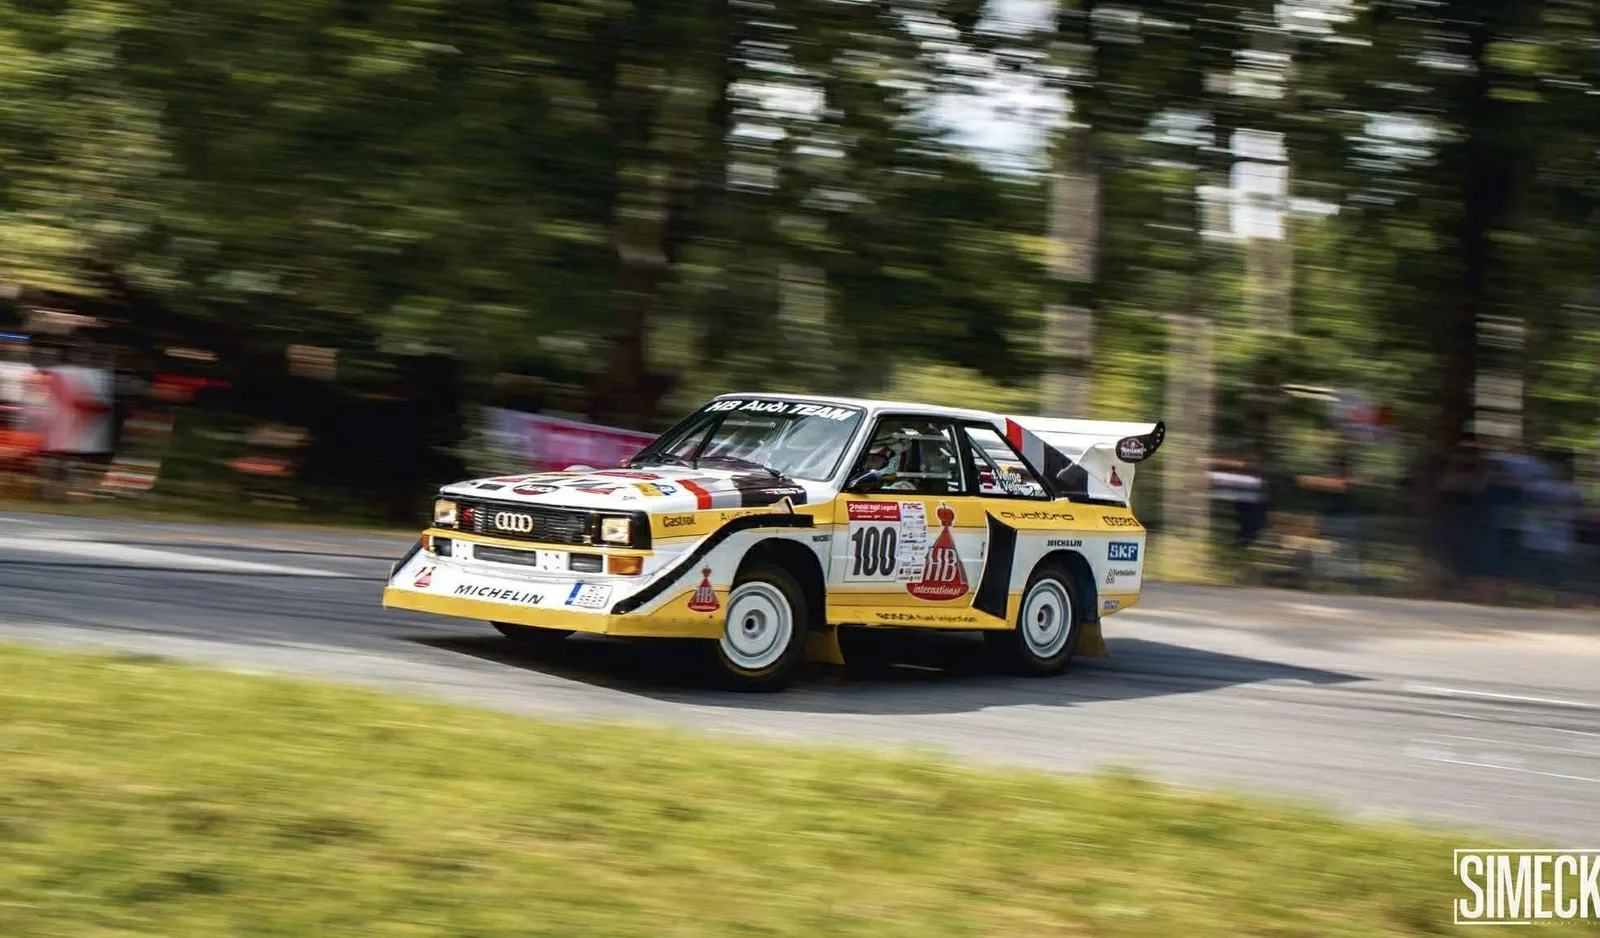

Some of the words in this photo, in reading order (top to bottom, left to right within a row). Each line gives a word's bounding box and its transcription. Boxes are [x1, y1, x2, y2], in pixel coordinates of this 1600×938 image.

[705, 401, 742, 412] HB
[740, 400, 784, 412] Audi
[789, 404, 857, 421] TEAM
[849, 504, 855, 512] 2
[1000, 511, 1075, 521] quattro
[662, 514, 696, 528] Castrol
[852, 526, 897, 577] 100
[1110, 544, 1137, 558] SKF
[925, 548, 958, 582] HB
[454, 584, 545, 605] MICHELIN
[696, 586, 713, 604] HB
[913, 584, 961, 596] international
